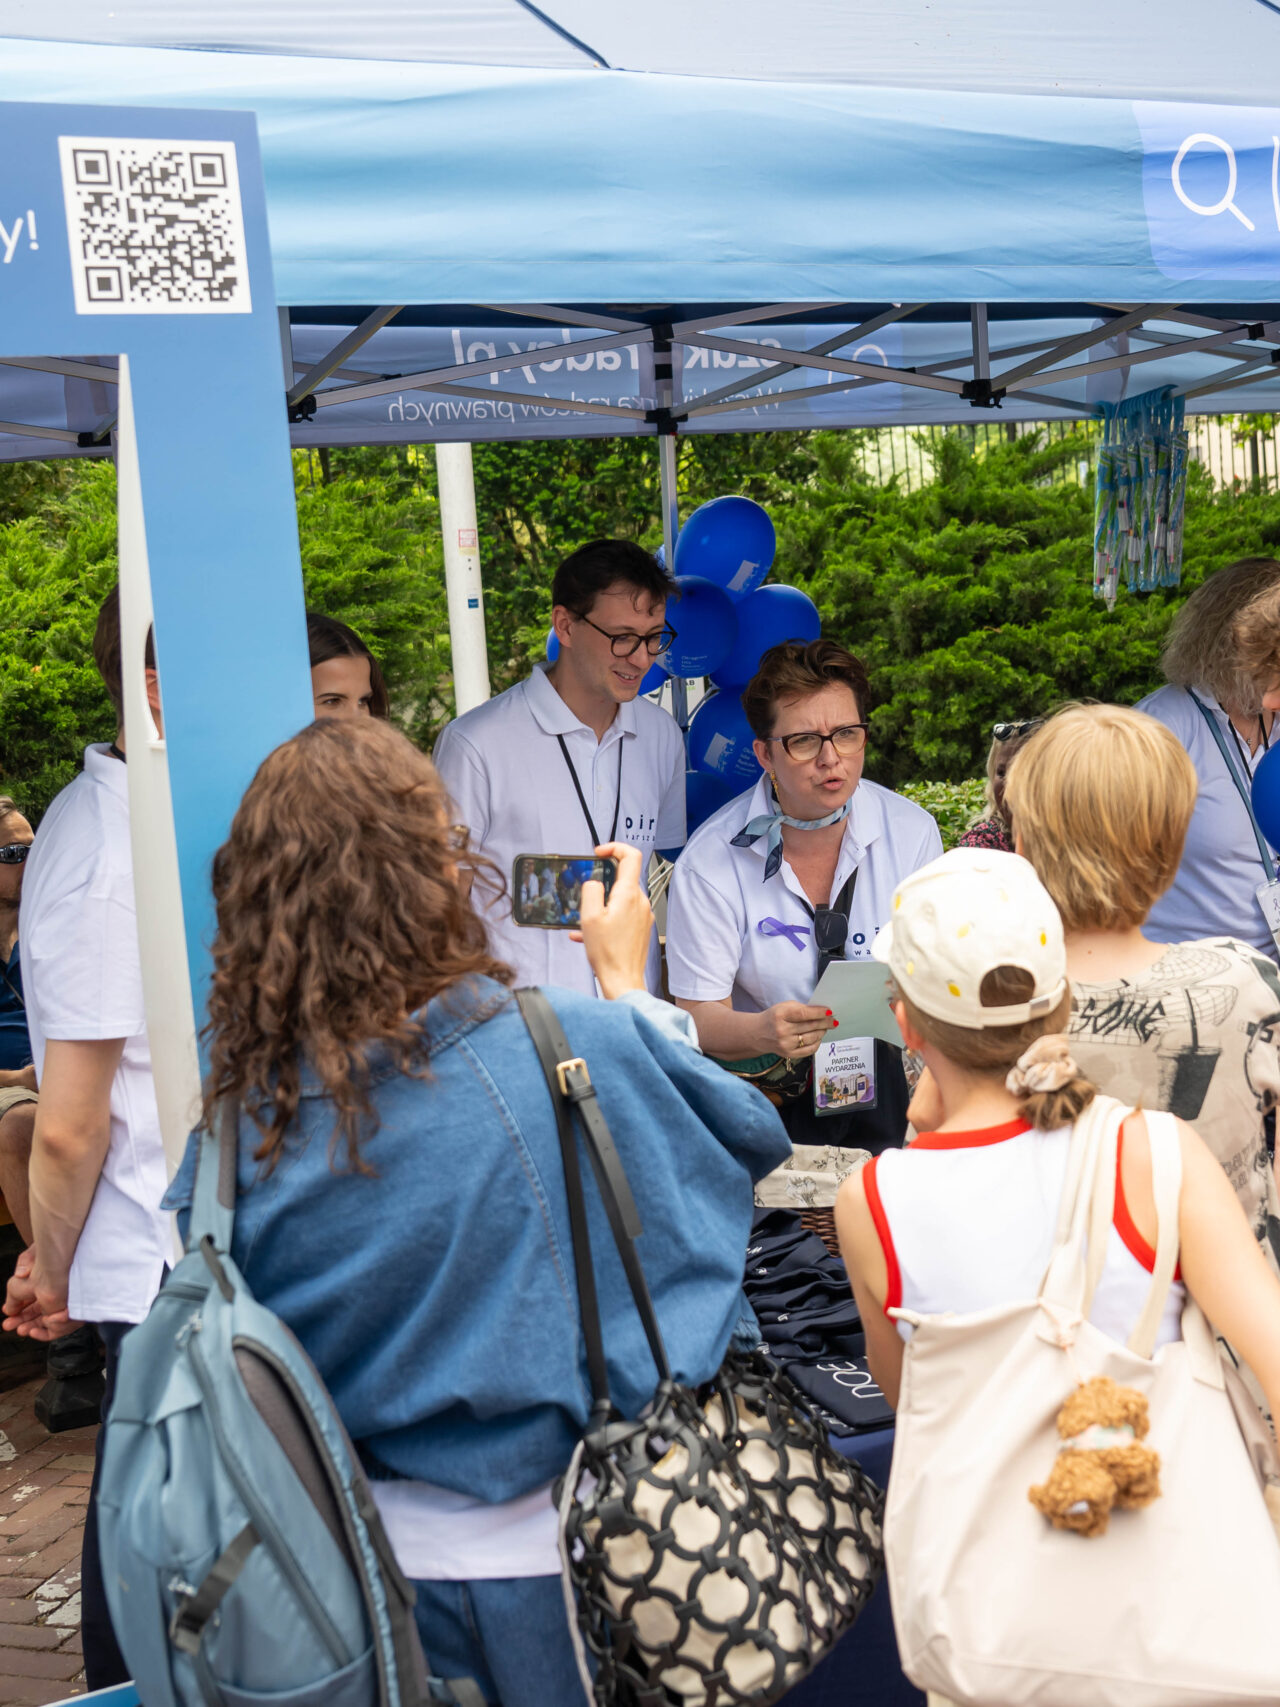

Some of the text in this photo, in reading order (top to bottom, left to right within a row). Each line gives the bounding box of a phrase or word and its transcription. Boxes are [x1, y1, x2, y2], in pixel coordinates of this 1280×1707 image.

[625, 815, 655, 830] oir
[831, 1055, 859, 1066] PARTNER
[824, 1062, 866, 1073] WYDARZENIA
